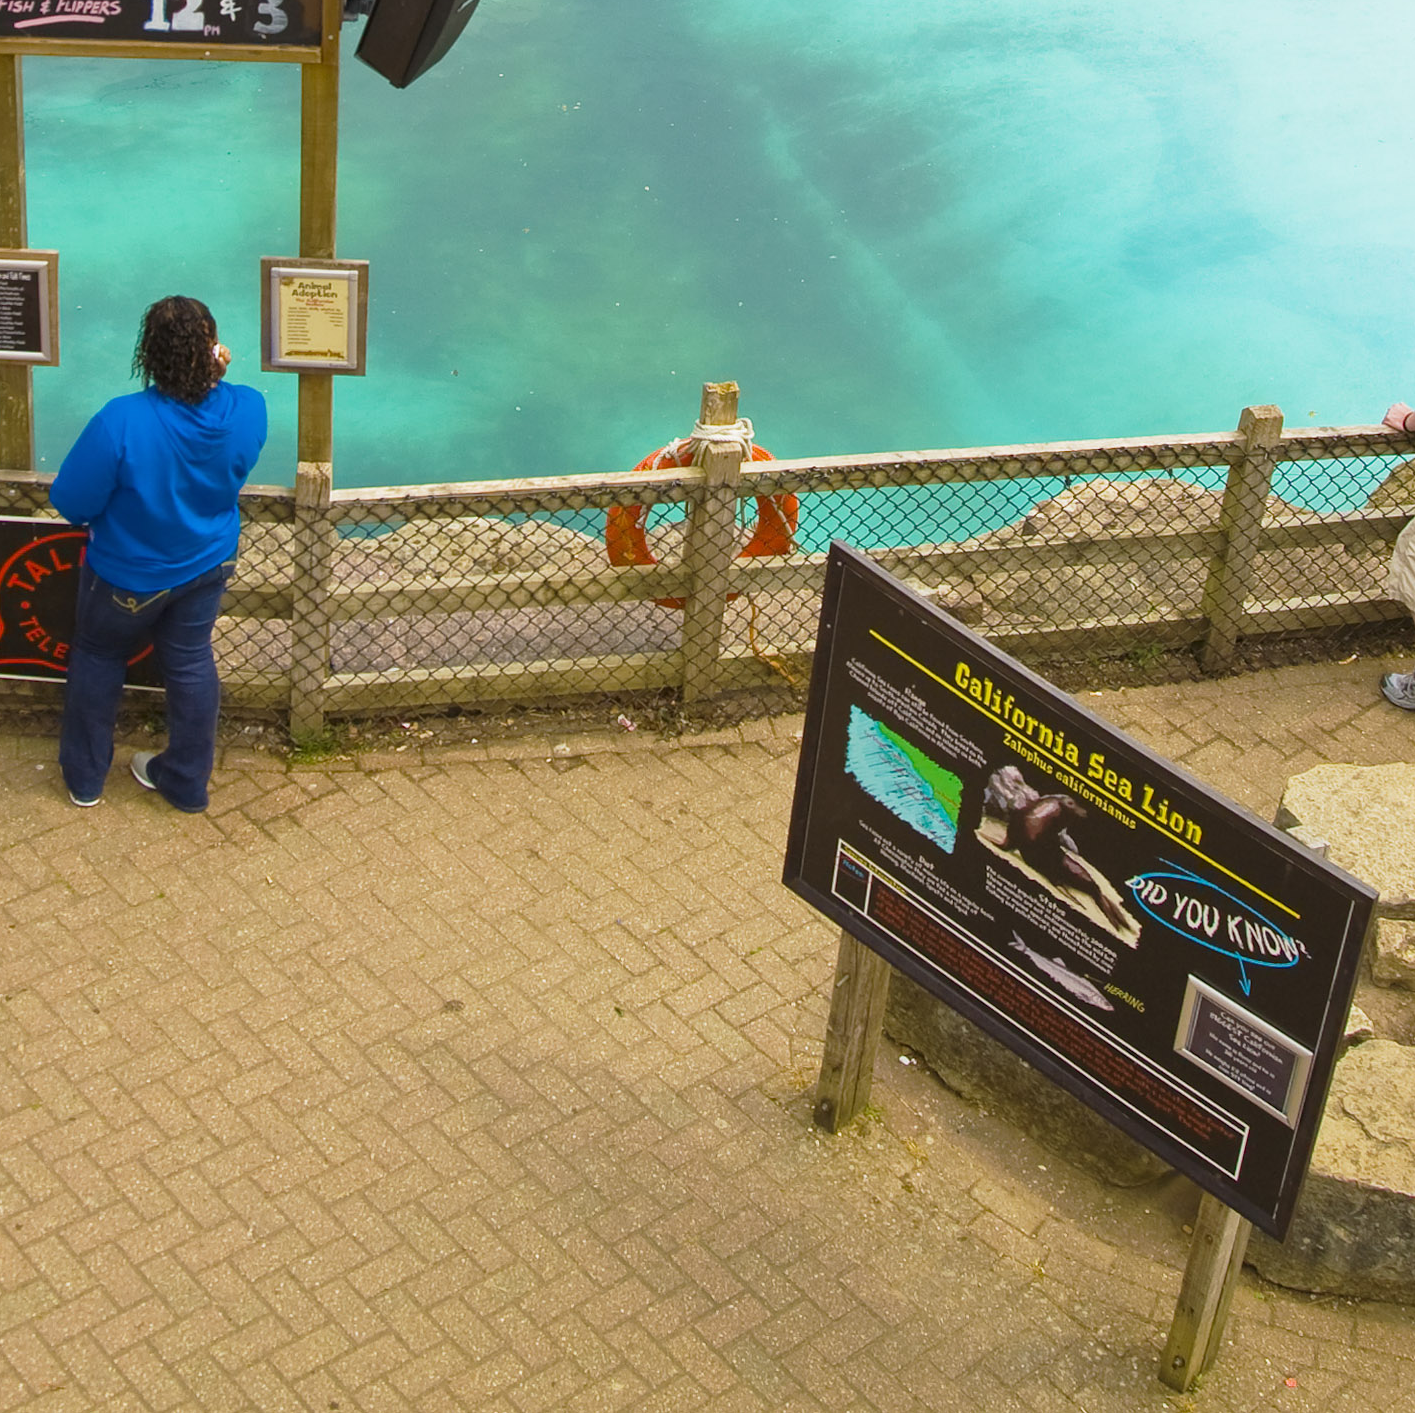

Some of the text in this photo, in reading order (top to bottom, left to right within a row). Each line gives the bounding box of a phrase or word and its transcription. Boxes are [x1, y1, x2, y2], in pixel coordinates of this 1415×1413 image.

[291, 289, 338, 298] Adoption
[297, 282, 332, 290] Animal
[954, 660, 1203, 846] California Sea Lion
[1002, 733, 1136, 830] Zalophus californianus
[1039, 894, 1066, 917] Status
[1124, 874, 1312, 962] DID YOU KNOW?
[1103, 982, 1146, 1014] HERRING
